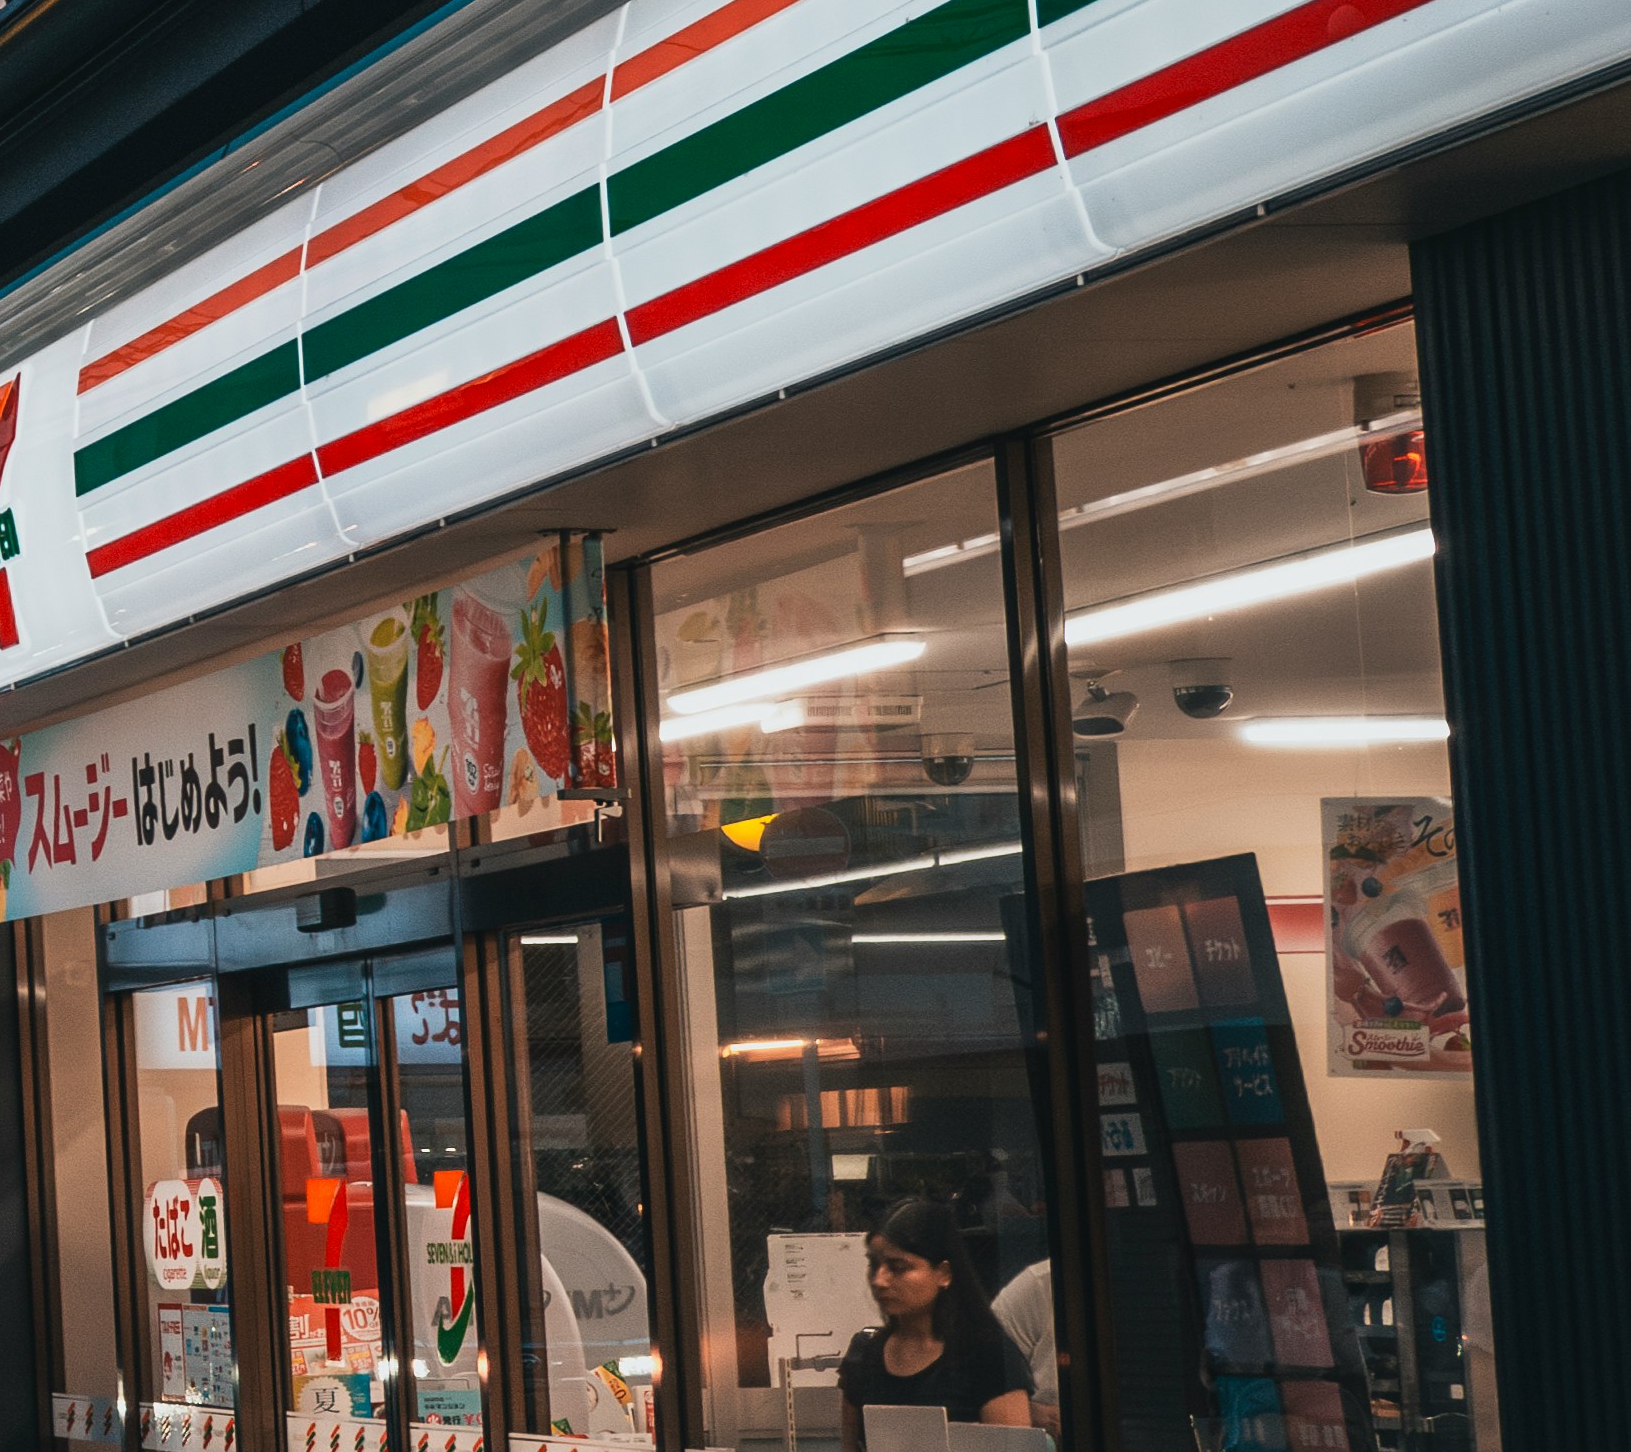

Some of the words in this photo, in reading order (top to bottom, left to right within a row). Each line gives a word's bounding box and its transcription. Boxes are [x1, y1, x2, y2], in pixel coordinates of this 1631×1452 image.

[1348, 1029, 1425, 1056] Smoothie
[152, 1196, 194, 1261] たばこ
[199, 1195, 219, 1259] 酒
[162, 1266, 188, 1283] cigarette
[312, 1386, 341, 1415] 夏
